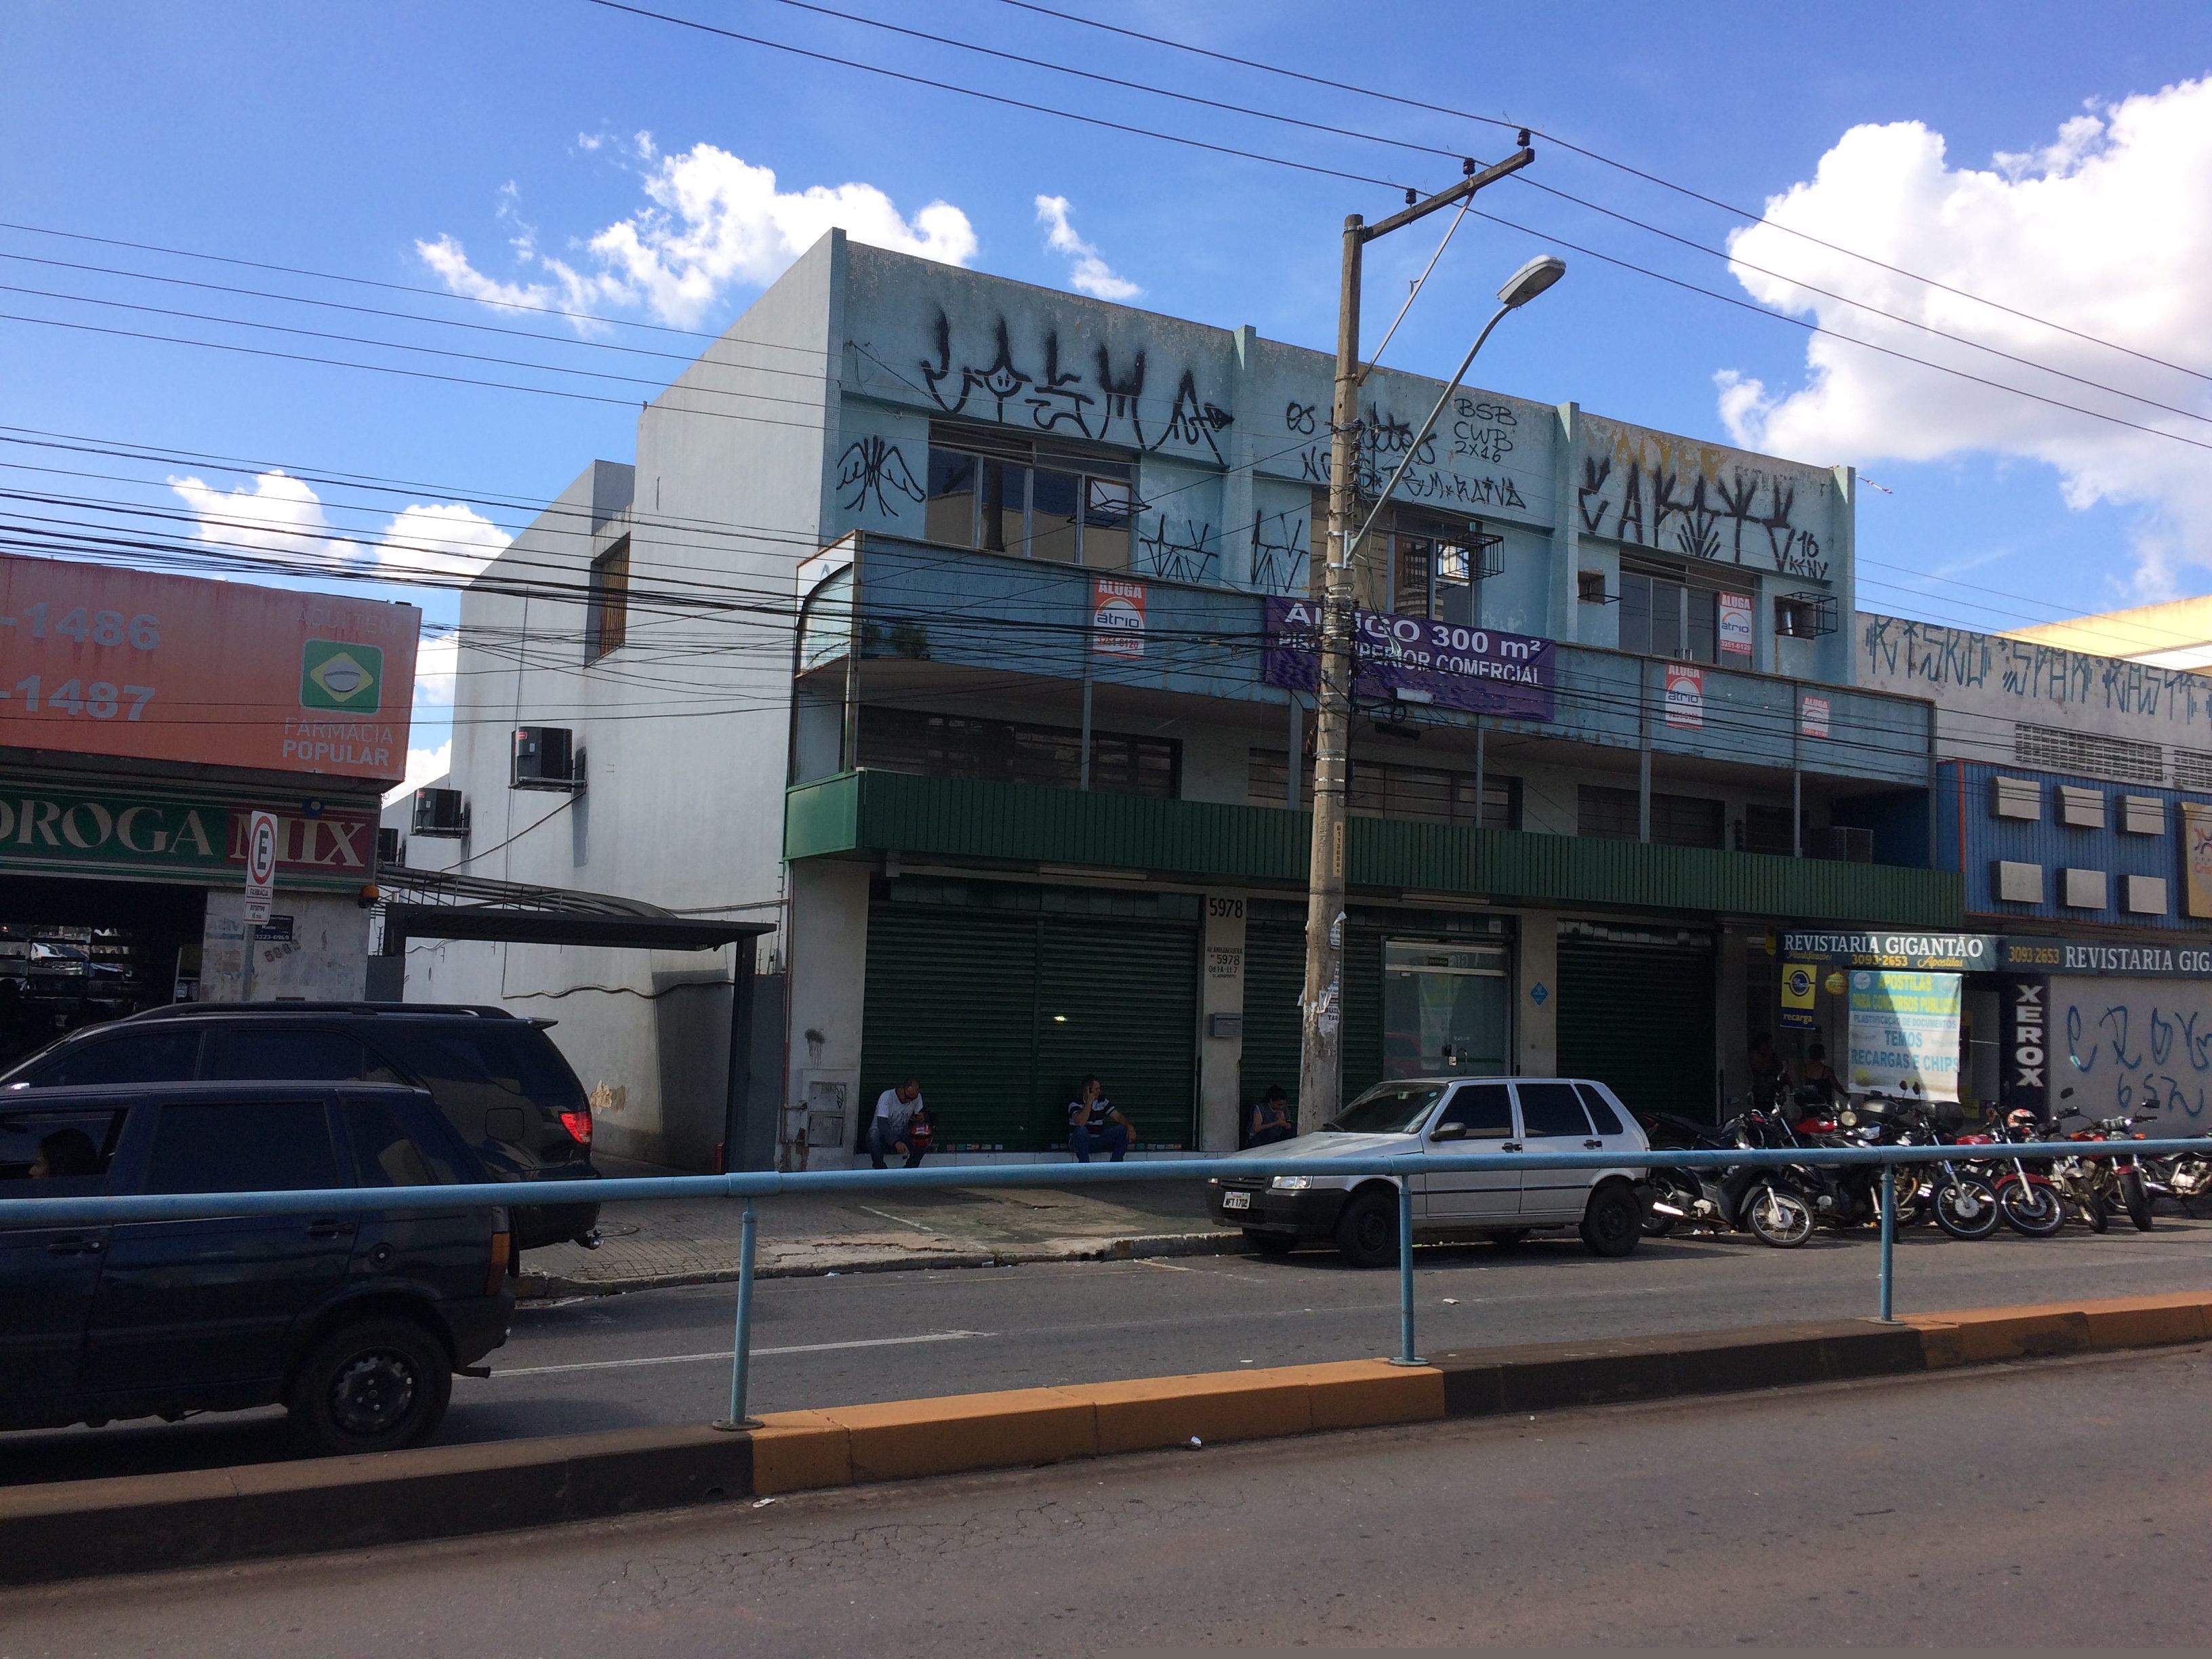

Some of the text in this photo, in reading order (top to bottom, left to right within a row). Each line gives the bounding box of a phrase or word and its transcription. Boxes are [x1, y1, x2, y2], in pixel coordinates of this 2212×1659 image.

[1454, 398, 1517, 426] BSB
[1453, 421, 1513, 452] CWB
[1098, 579, 1143, 598] ALUGA
[1721, 594, 1751, 610] ALUGA
[1432, 626, 1488, 653] 300
[1436, 654, 1544, 686] COMERCIAL
[1668, 665, 1700, 678] ALUGA
[1804, 697, 1828, 709] ALUGA
[284, 716, 394, 744] FARMÁCIA
[282, 739, 390, 766] POPULAR
[257, 830, 269, 871] E
[1209, 897, 1244, 919] 5978
[1784, 934, 1984, 958] REVISTARIA GIGANTÃO
[1216, 954, 1240, 966] 5978
[2065, 945, 2173, 971] REVISTARIA
[2179, 949, 2212, 972] GIG
[1877, 973, 1932, 991] APOSTILAS
[1783, 1013, 1813, 1024] recarga
[1902, 1017, 1911, 1026] DE
[1912, 1017, 1957, 1029] DOCUMENTOS
[1884, 1029, 1923, 1048] TEMOS
[2015, 984, 2044, 1088] XEROX
[1851, 1048, 1959, 1073] RECARGAS E CHIPS
